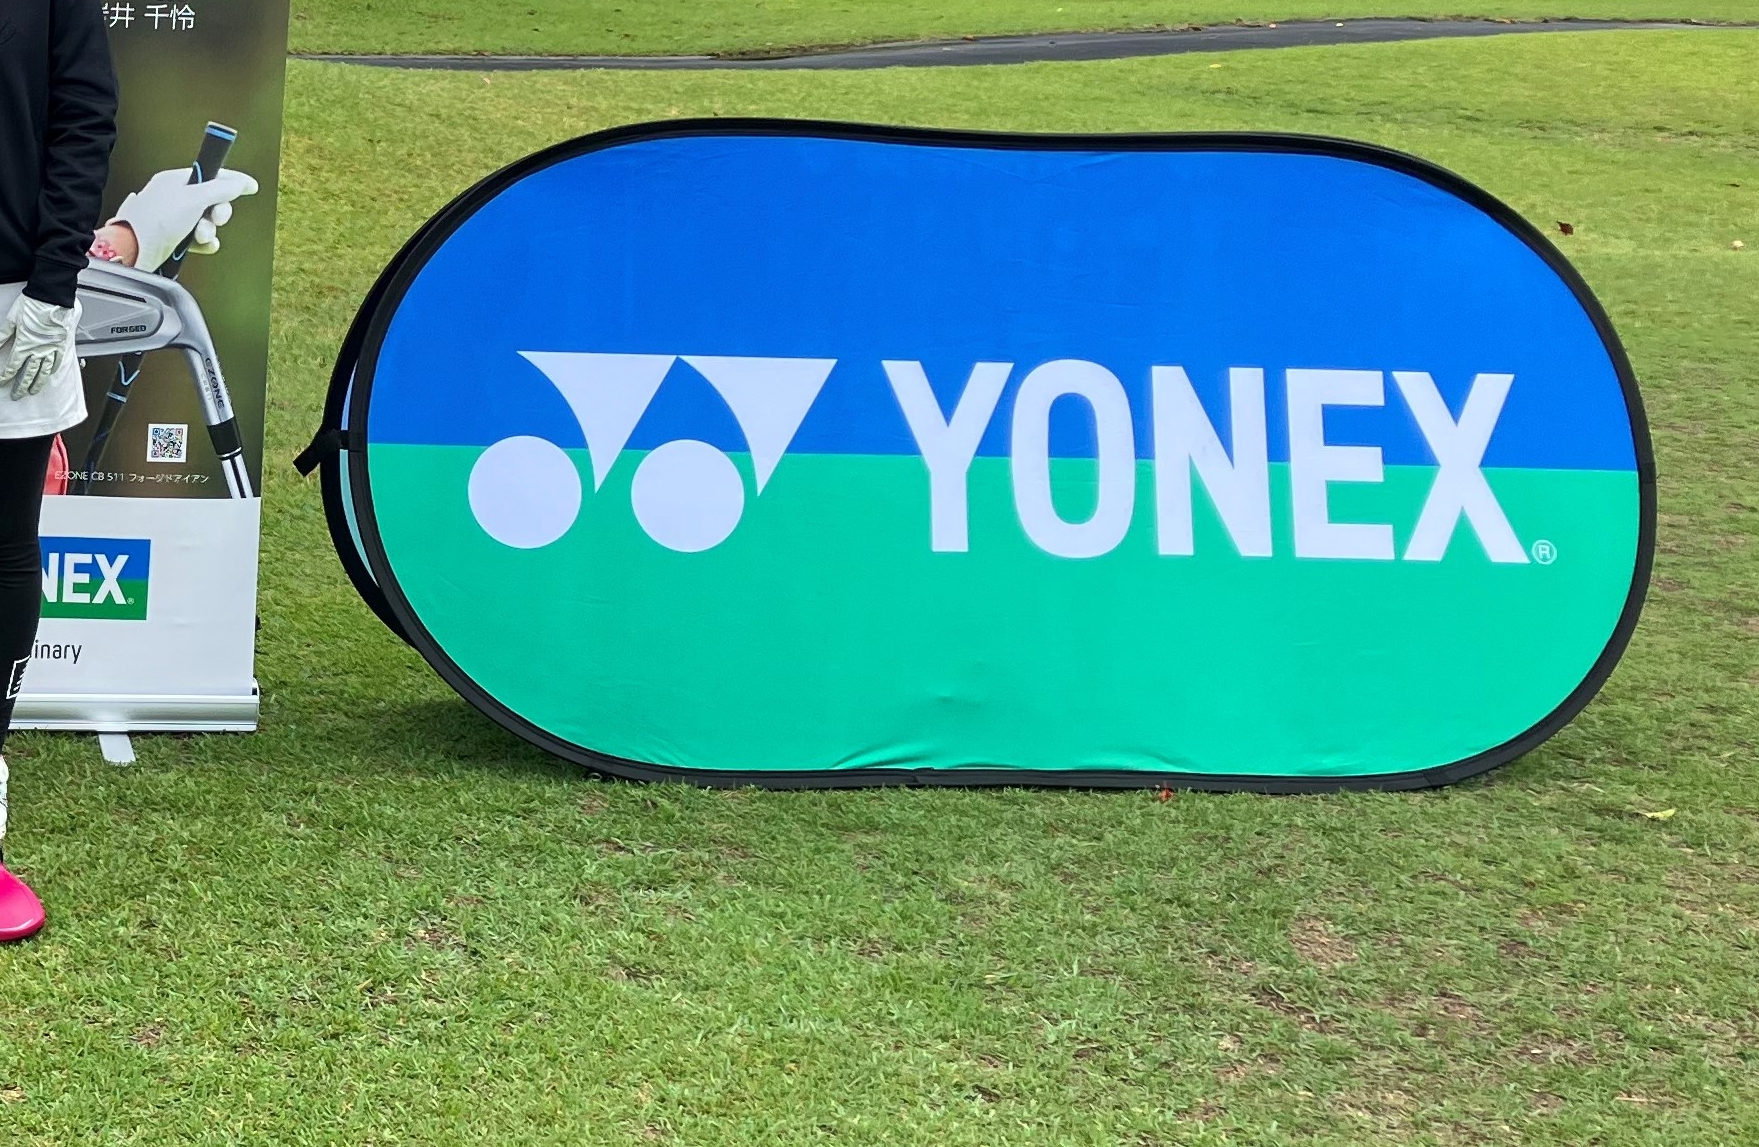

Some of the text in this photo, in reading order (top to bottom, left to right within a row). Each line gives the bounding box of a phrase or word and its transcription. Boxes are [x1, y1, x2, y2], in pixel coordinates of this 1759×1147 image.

[144, 4, 196, 30] 千怜
[110, 325, 147, 334] FORGED
[54, 470, 210, 483] EZONE CB 511 フォージドアイアン
[41, 552, 130, 605] NEX
[34, 640, 83, 664] inary
